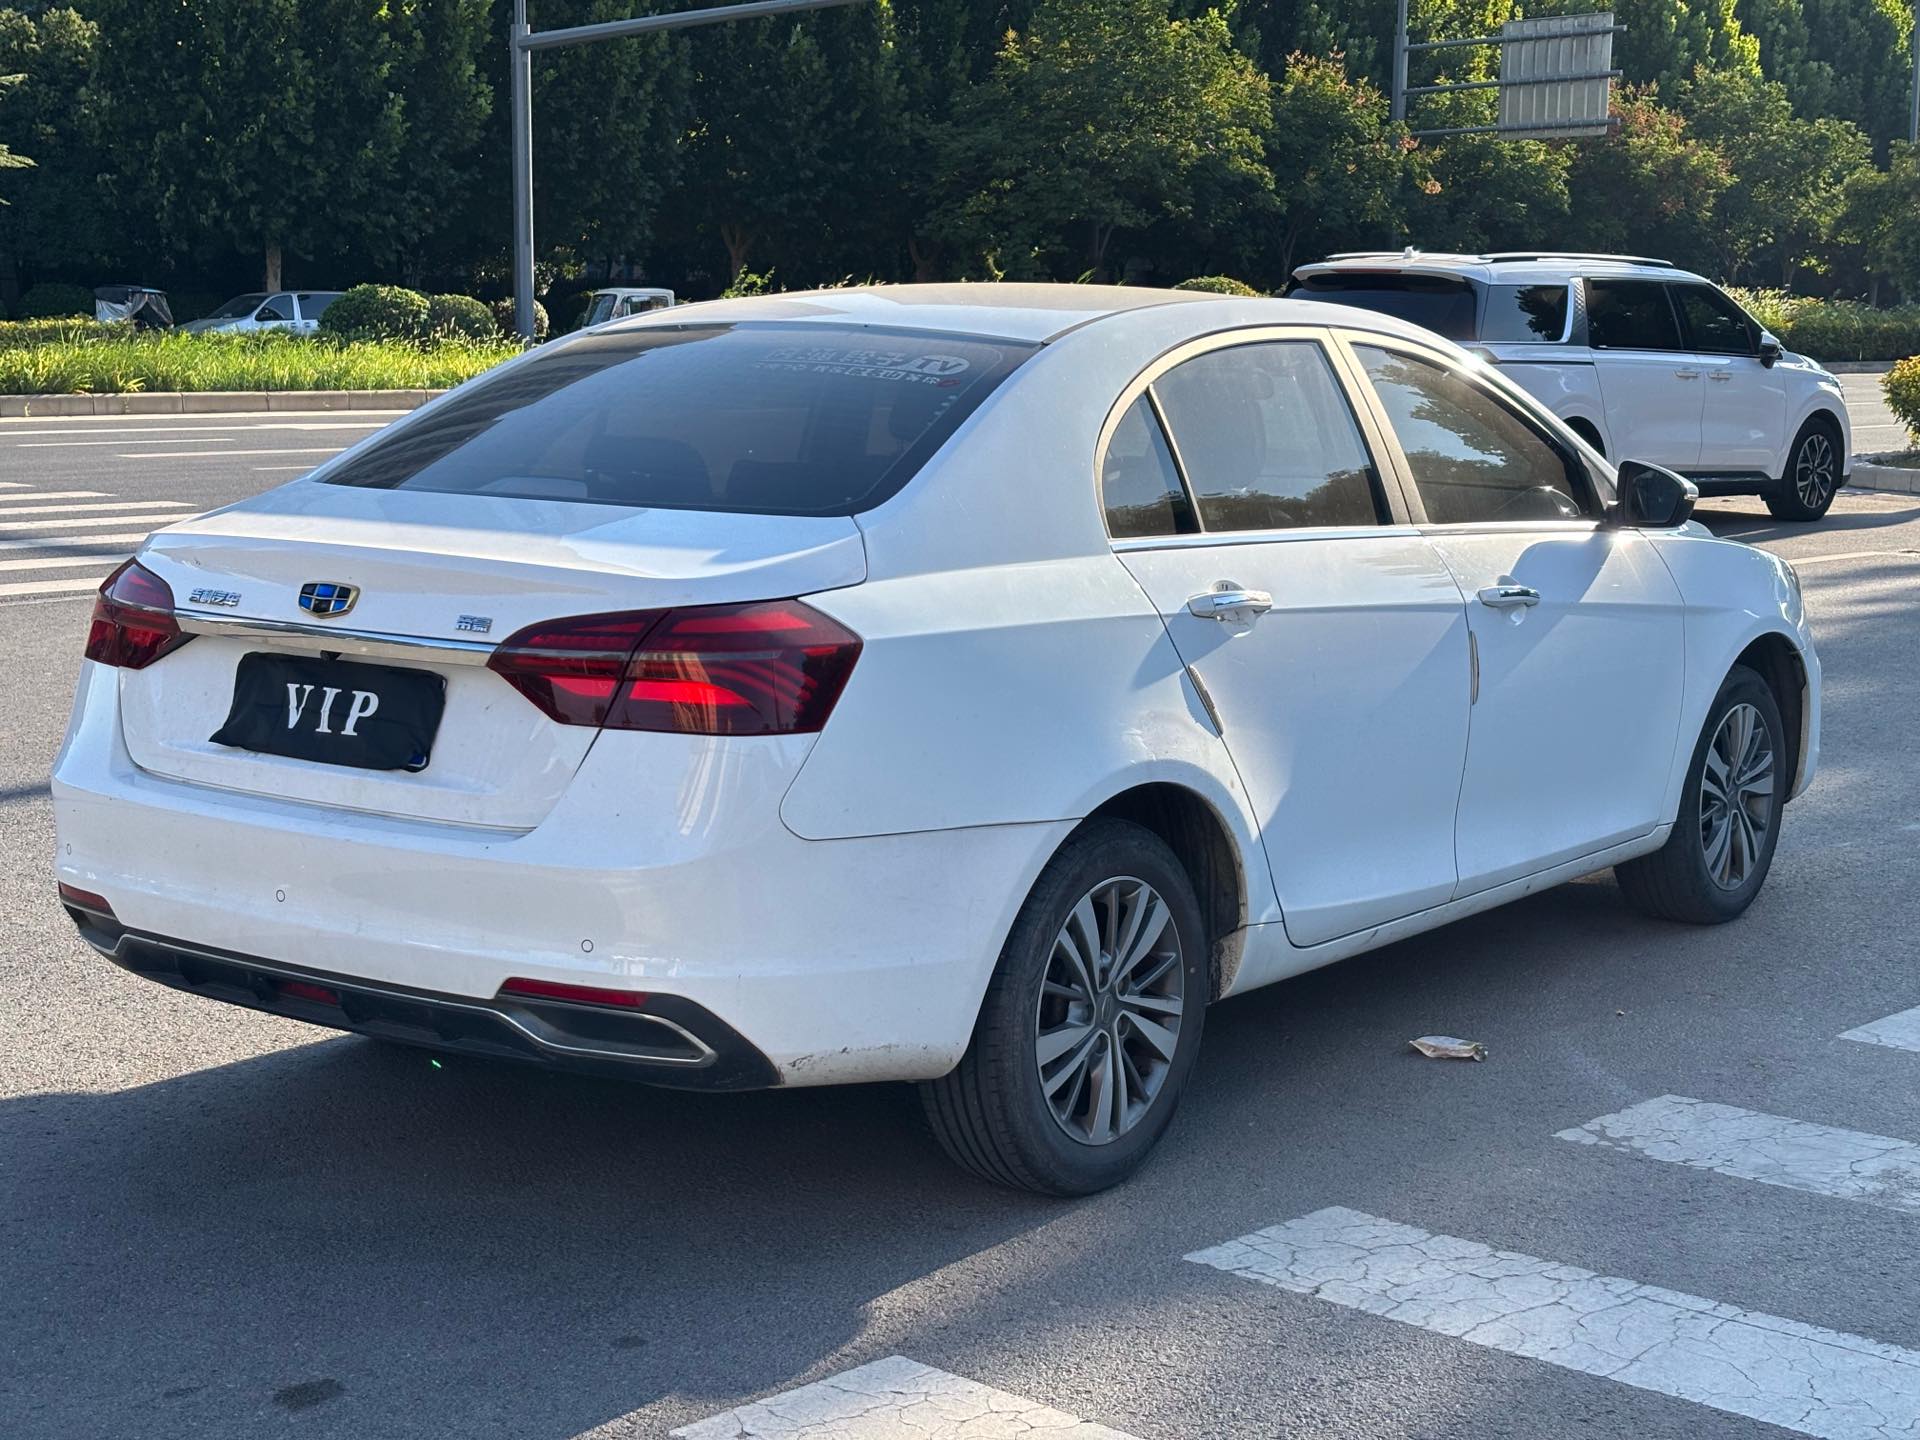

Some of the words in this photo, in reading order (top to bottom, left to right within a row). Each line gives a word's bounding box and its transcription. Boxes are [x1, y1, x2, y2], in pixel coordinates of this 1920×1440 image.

[915, 357, 963, 374] TV
[456, 615, 493, 633] 帝豪
[286, 683, 379, 736] VIP
